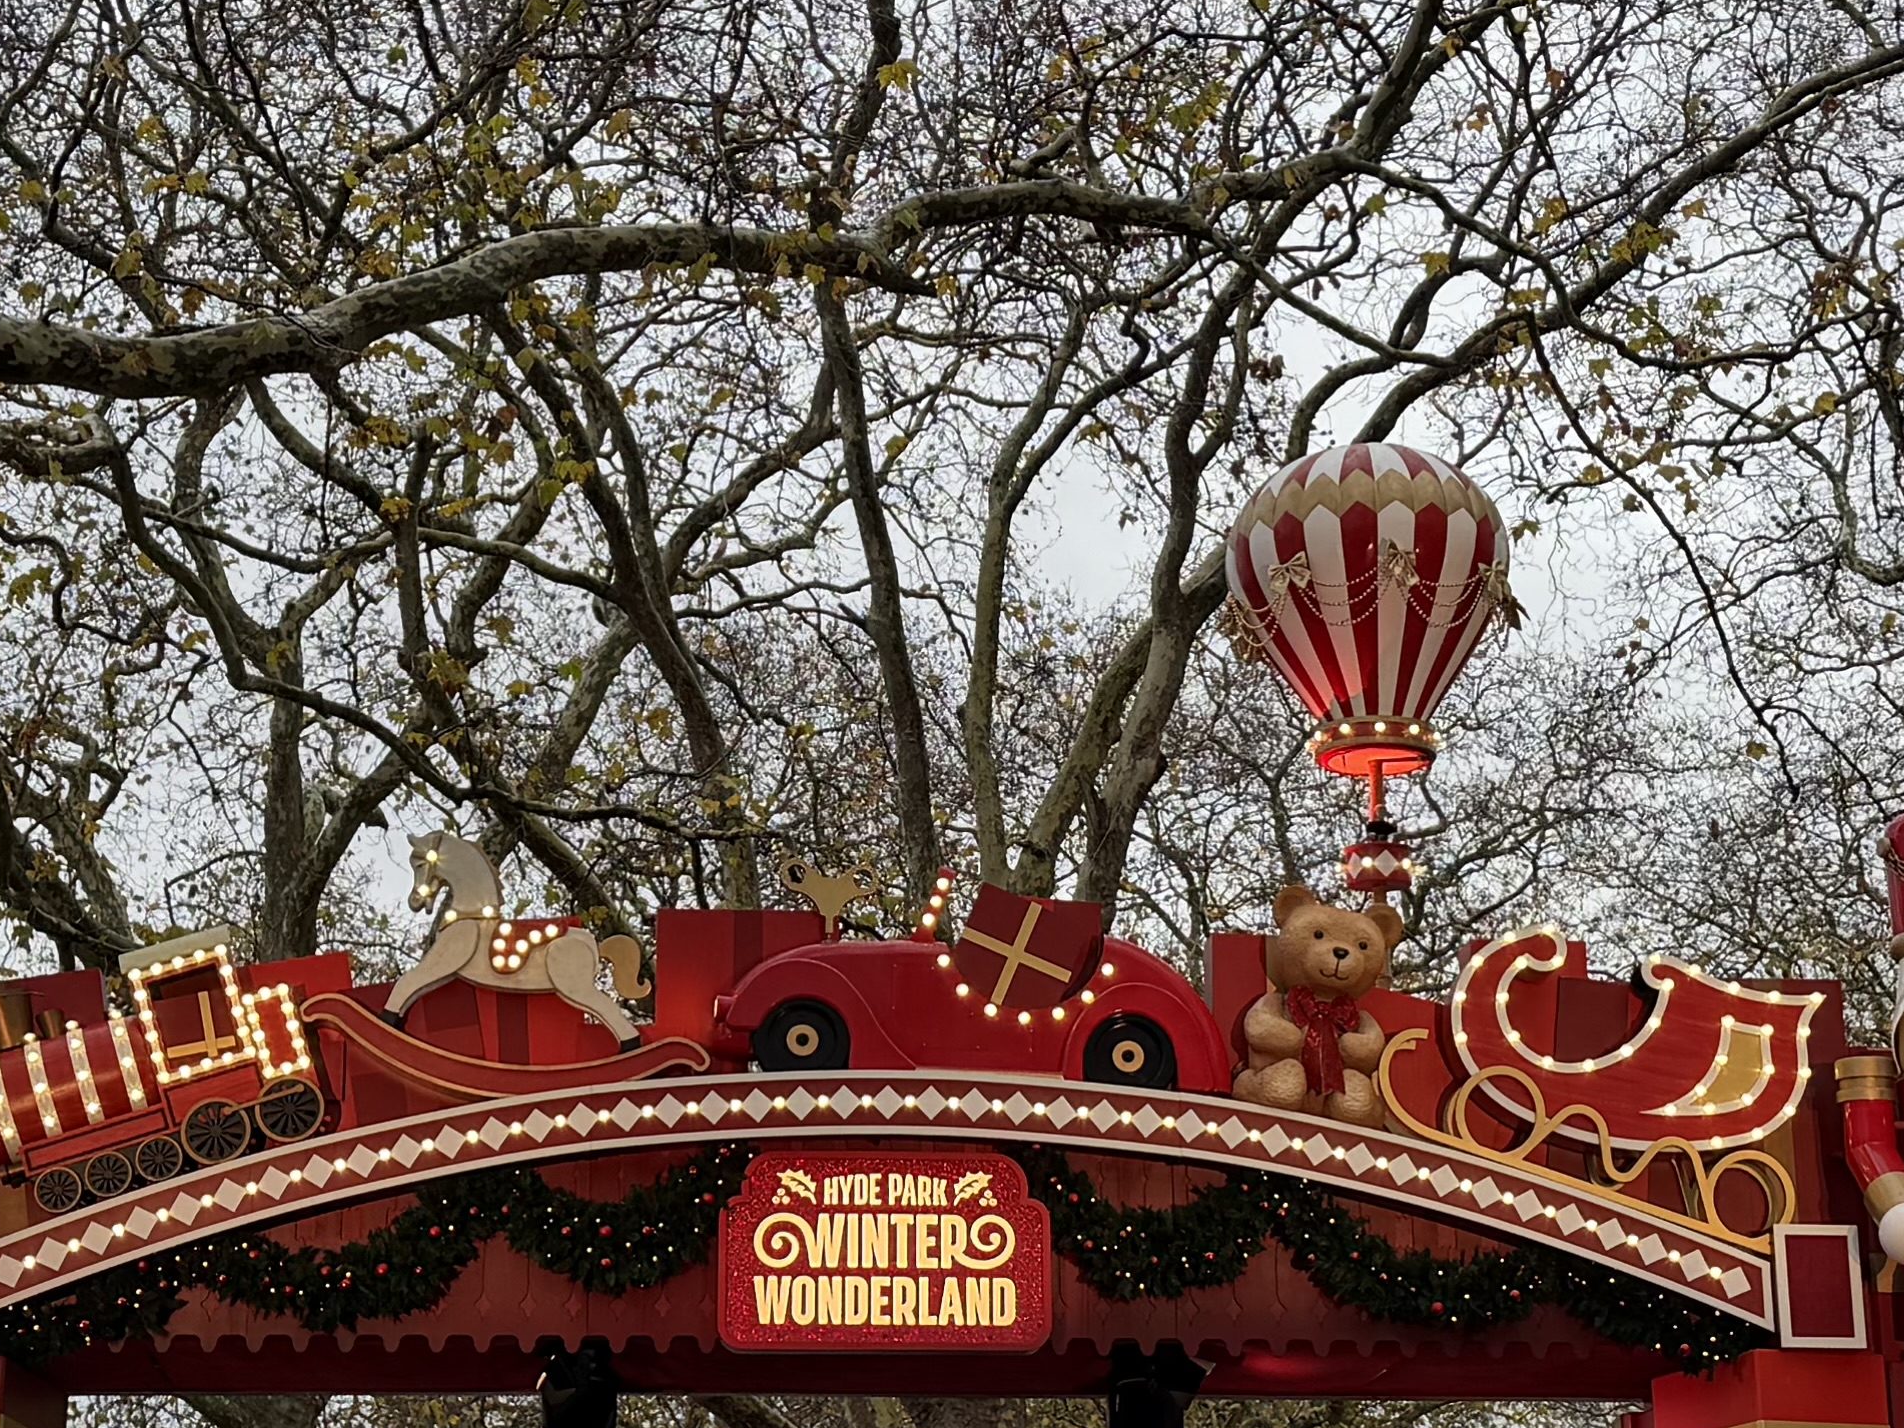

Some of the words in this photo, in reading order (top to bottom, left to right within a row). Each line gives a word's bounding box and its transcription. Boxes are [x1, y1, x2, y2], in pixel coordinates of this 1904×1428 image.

[823, 1173, 882, 1206] HYDE
[888, 1173, 948, 1206] PARK
[753, 1212, 1016, 1270] WINTER
[753, 1275, 1018, 1326] WONDERLAND
